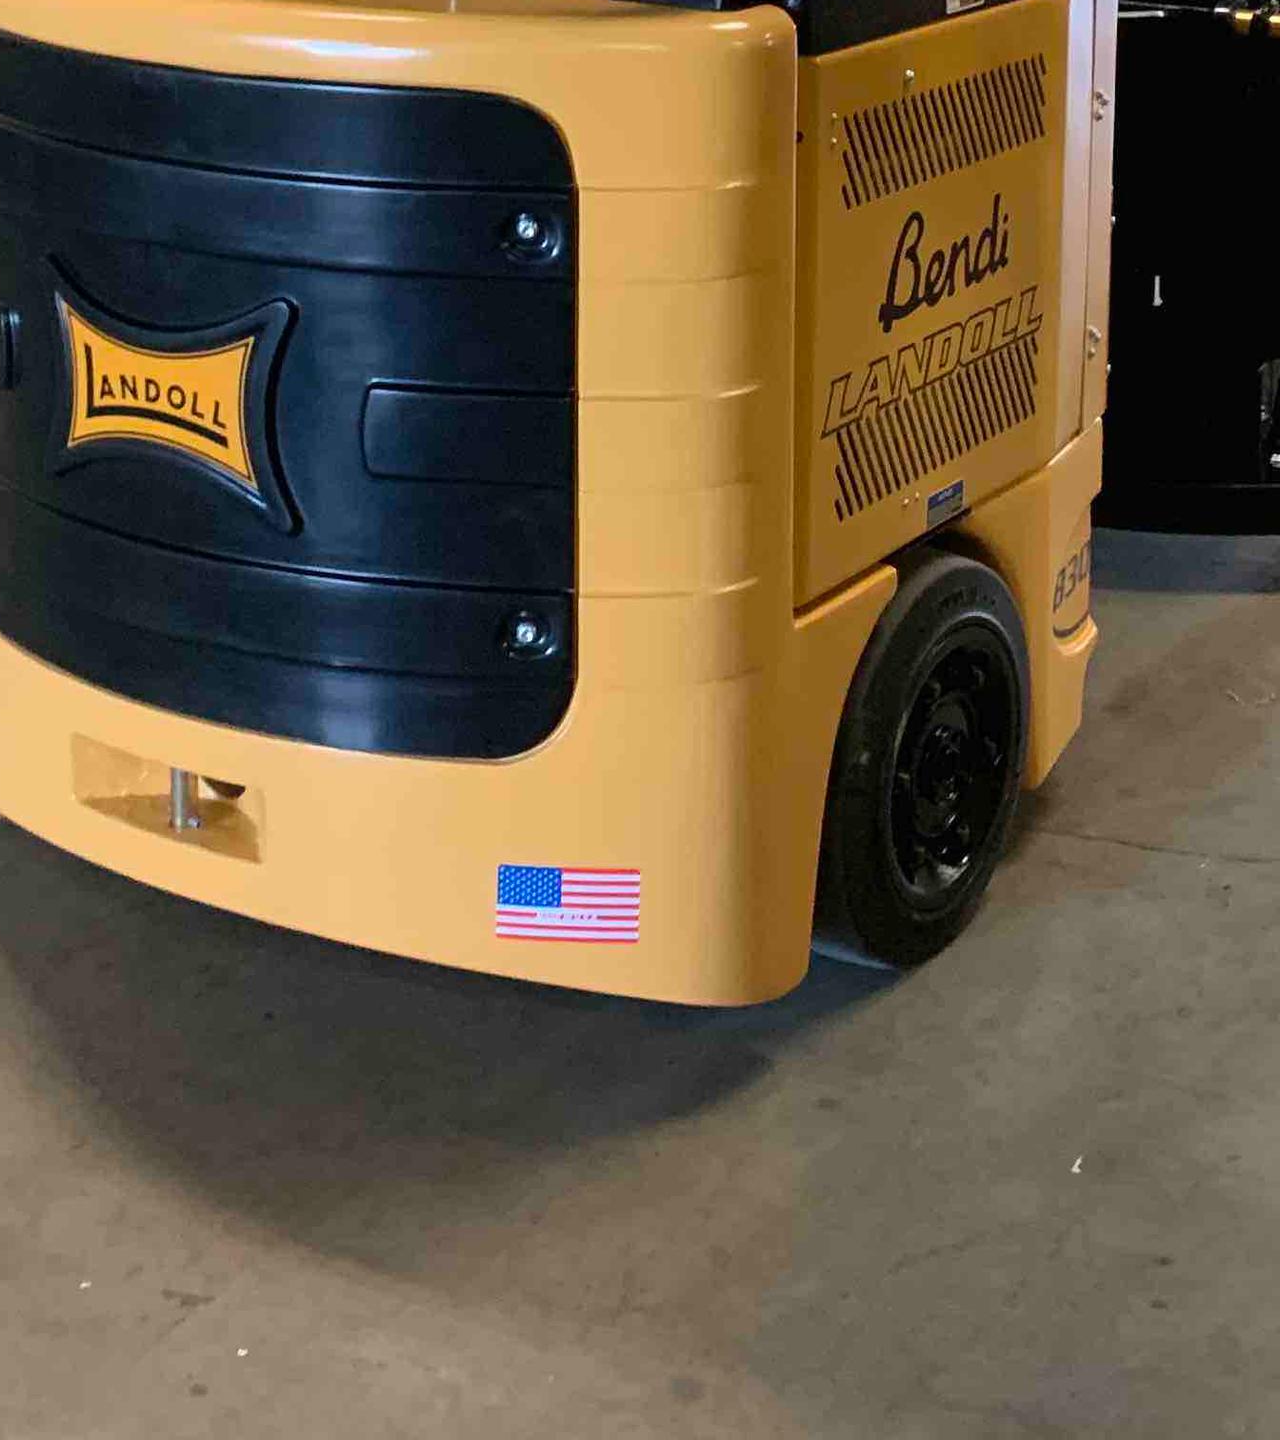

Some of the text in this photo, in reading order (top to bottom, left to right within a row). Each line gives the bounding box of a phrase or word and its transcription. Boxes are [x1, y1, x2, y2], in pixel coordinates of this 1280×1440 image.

[878, 193, 1010, 333] Bendi
[84, 343, 229, 449] LANDOLL
[821, 285, 1044, 440] LANDOLL
